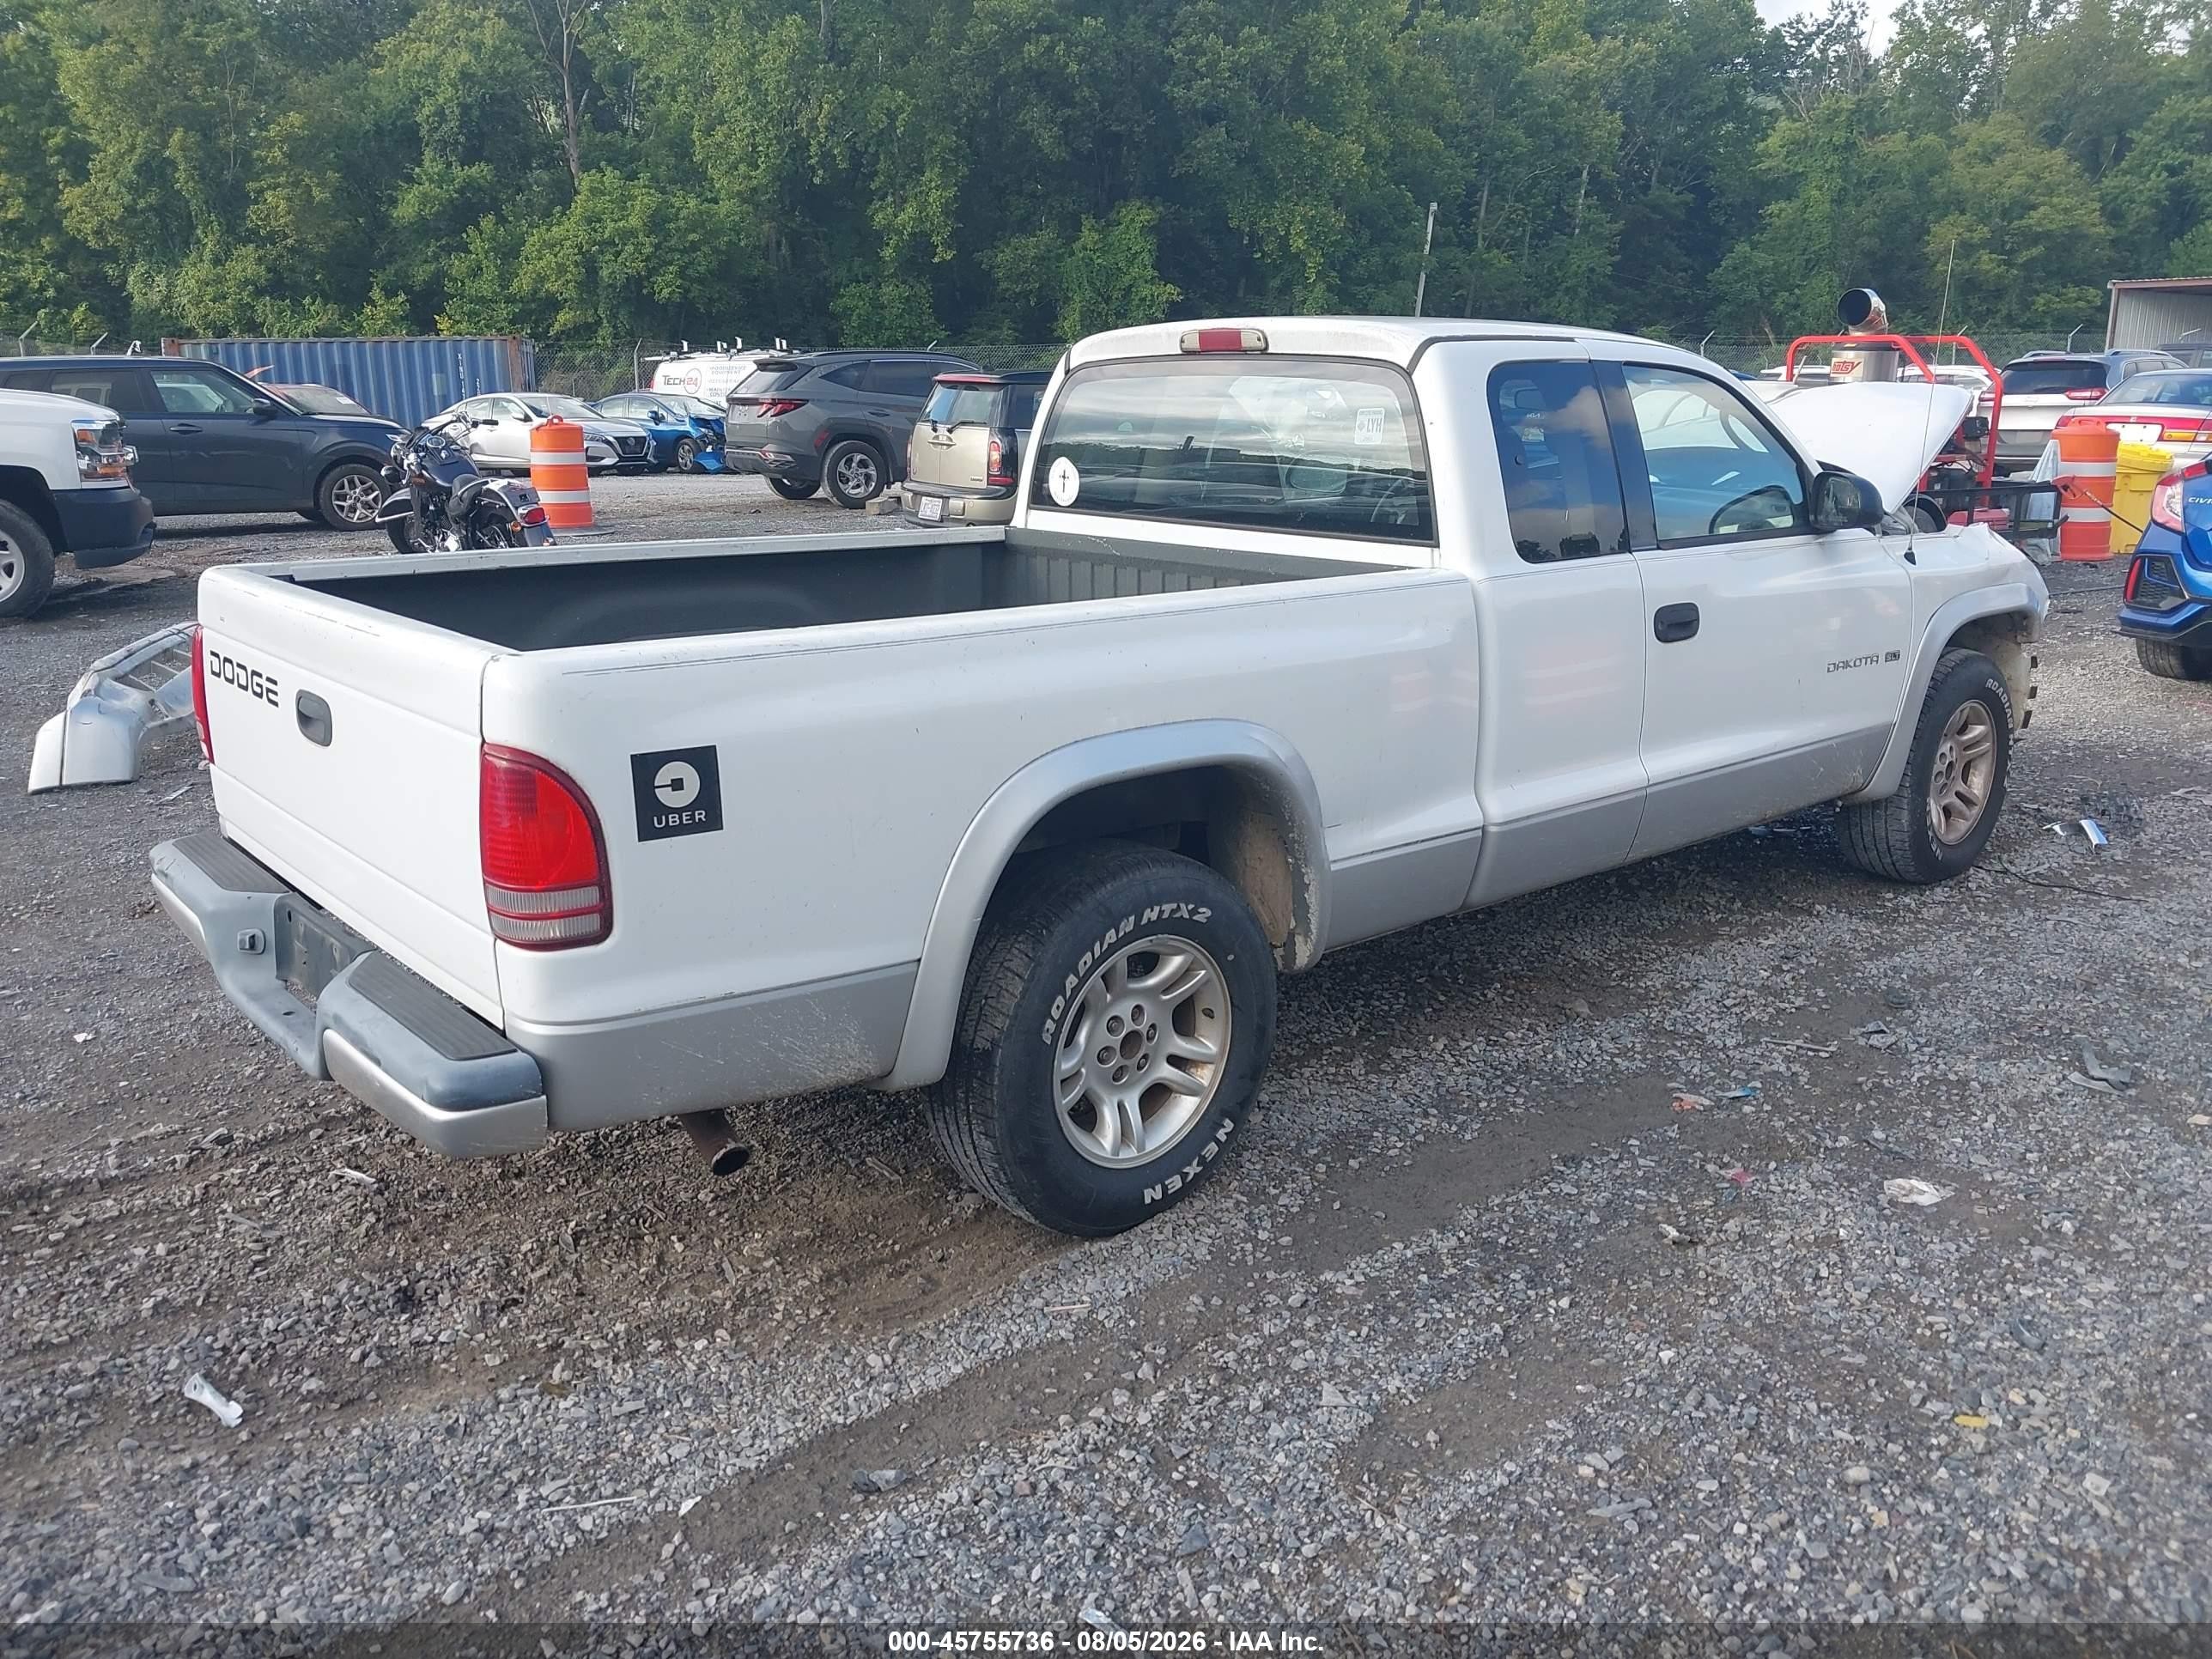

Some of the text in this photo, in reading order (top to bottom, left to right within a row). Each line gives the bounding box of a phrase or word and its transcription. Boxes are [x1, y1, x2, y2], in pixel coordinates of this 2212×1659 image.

[1366, 418, 1383, 434] LYH
[2188, 496, 2212, 505] CIVI
[1826, 650, 1901, 673] DAKOTA SLT
[210, 649, 279, 708] DODGE
[653, 810, 707, 828] UBER
[1042, 902, 1212, 1045] ROADIAN HTX2
[1143, 1118, 1235, 1204] NEXEN
